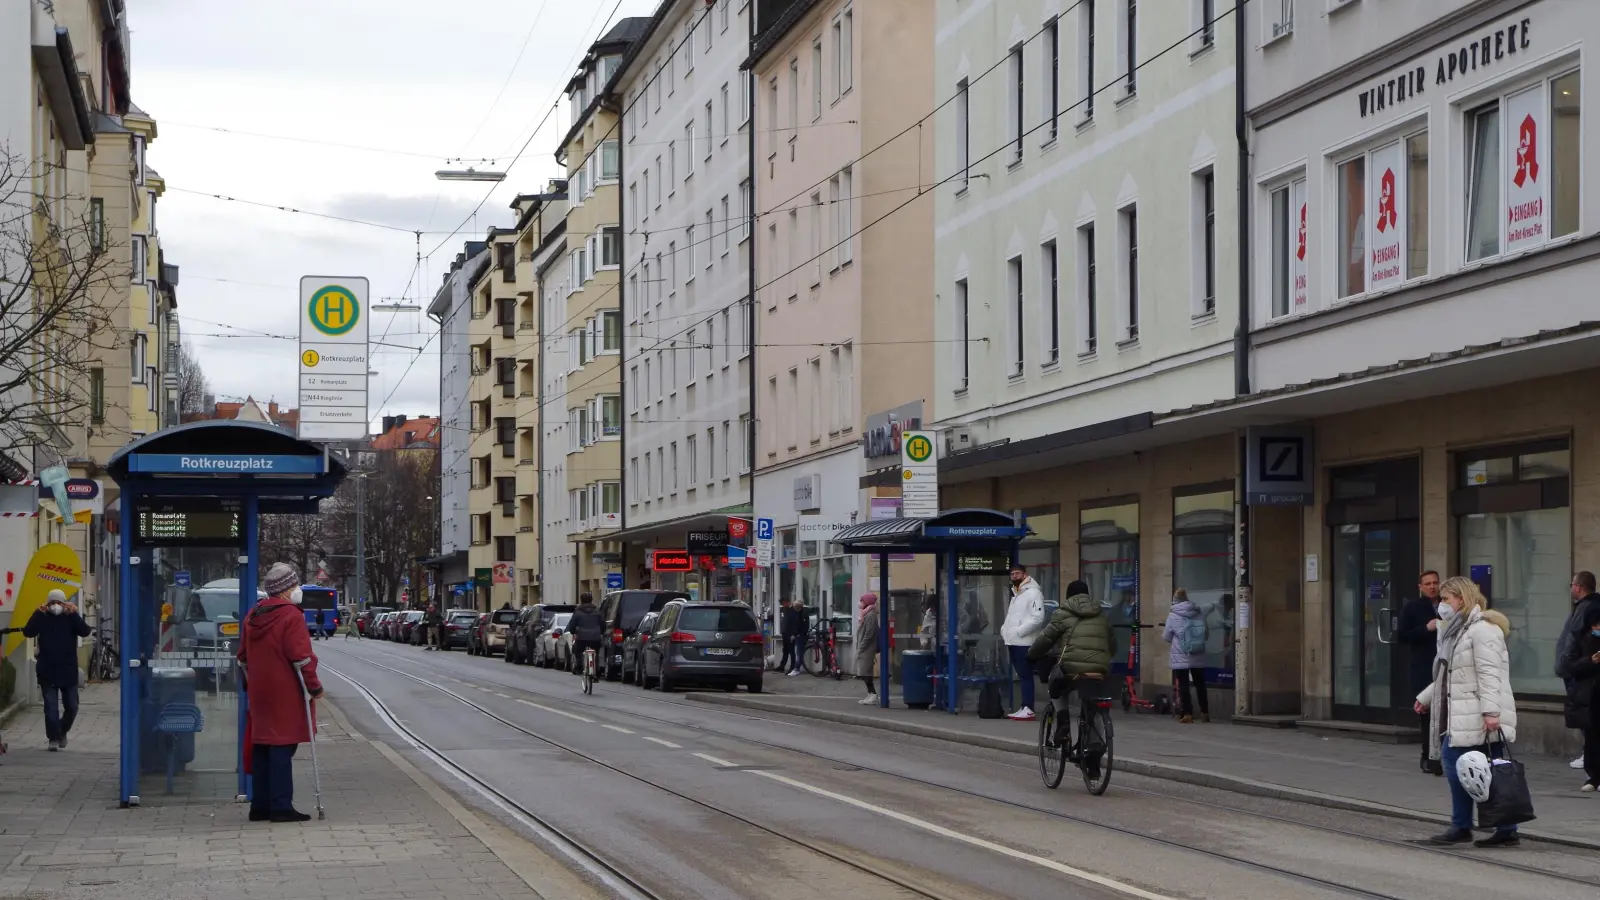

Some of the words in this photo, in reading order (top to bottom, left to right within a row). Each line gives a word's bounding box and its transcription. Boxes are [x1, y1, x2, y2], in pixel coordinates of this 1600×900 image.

[1358, 66, 1425, 118] WINTHIR
[1435, 17, 1531, 85] APOTHEKE
[1514, 200, 1538, 223] EINGANG
[1377, 244, 1397, 264] EINGANG
[307, 353, 314, 364] 1
[321, 355, 365, 363] Rotkreuzplatz
[181, 457, 273, 470] Rotkreuzplatz
[759, 520, 769, 537] P
[949, 527, 997, 536] Rotkreuzplatz
[690, 532, 727, 541] FRISEUR
[45, 563, 74, 576] DHL
[37, 572, 68, 585] PAKETSHOP
